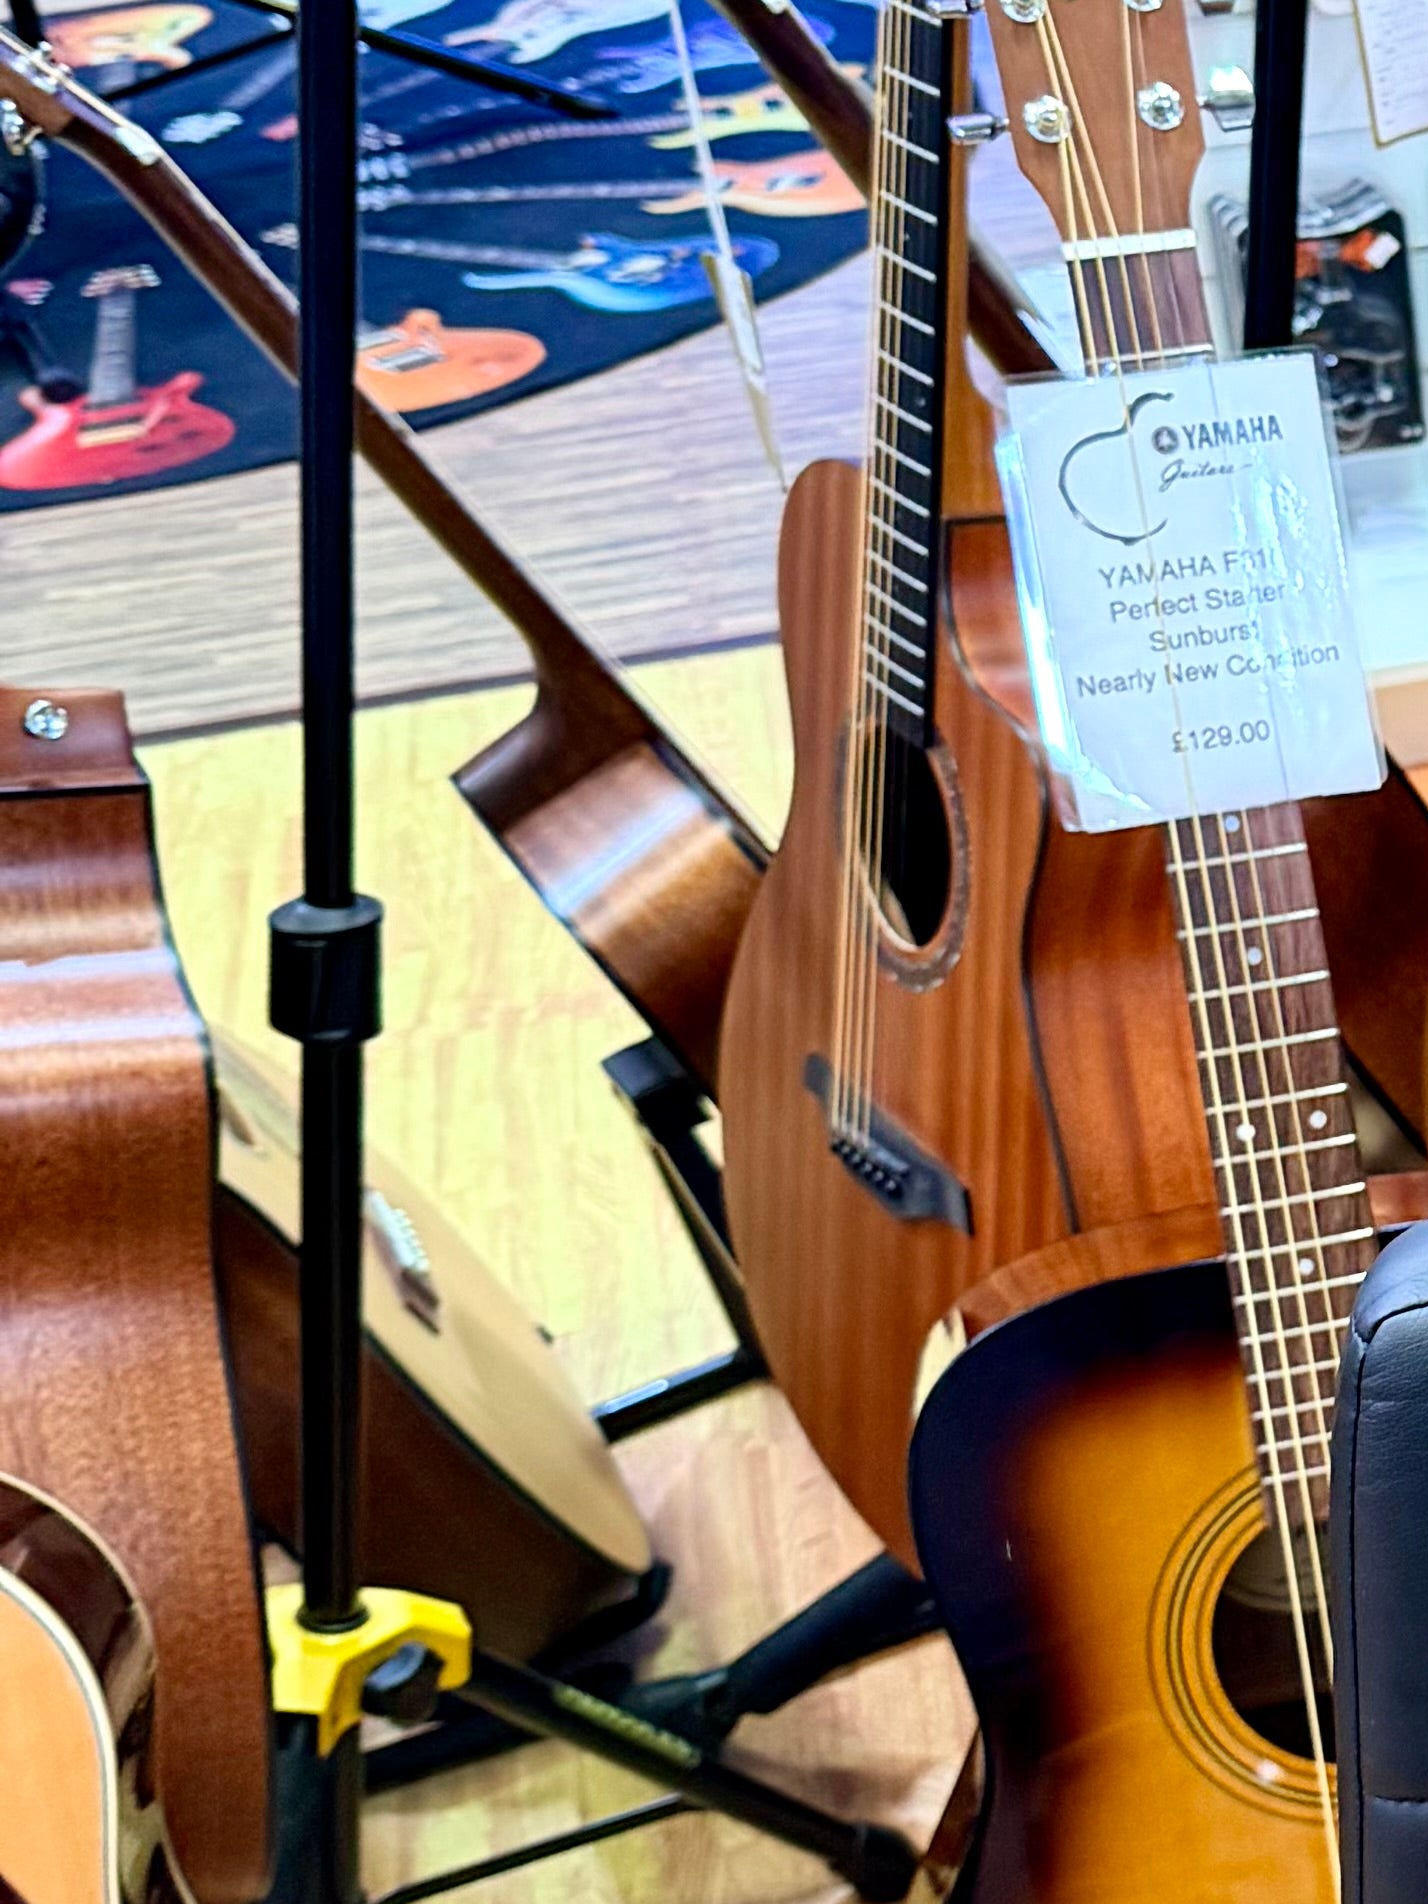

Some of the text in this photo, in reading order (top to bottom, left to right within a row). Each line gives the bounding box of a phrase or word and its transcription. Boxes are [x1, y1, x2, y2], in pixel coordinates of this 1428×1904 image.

[1181, 414, 1284, 450] YAMAHA
[1157, 458, 1237, 493] Guitars
[1098, 554, 1217, 590] YAMAHA
[1109, 592, 1199, 623] Perfect
[1076, 668, 1157, 700] Nearly
[1163, 661, 1219, 686] New
[1171, 719, 1271, 754] £129.00
